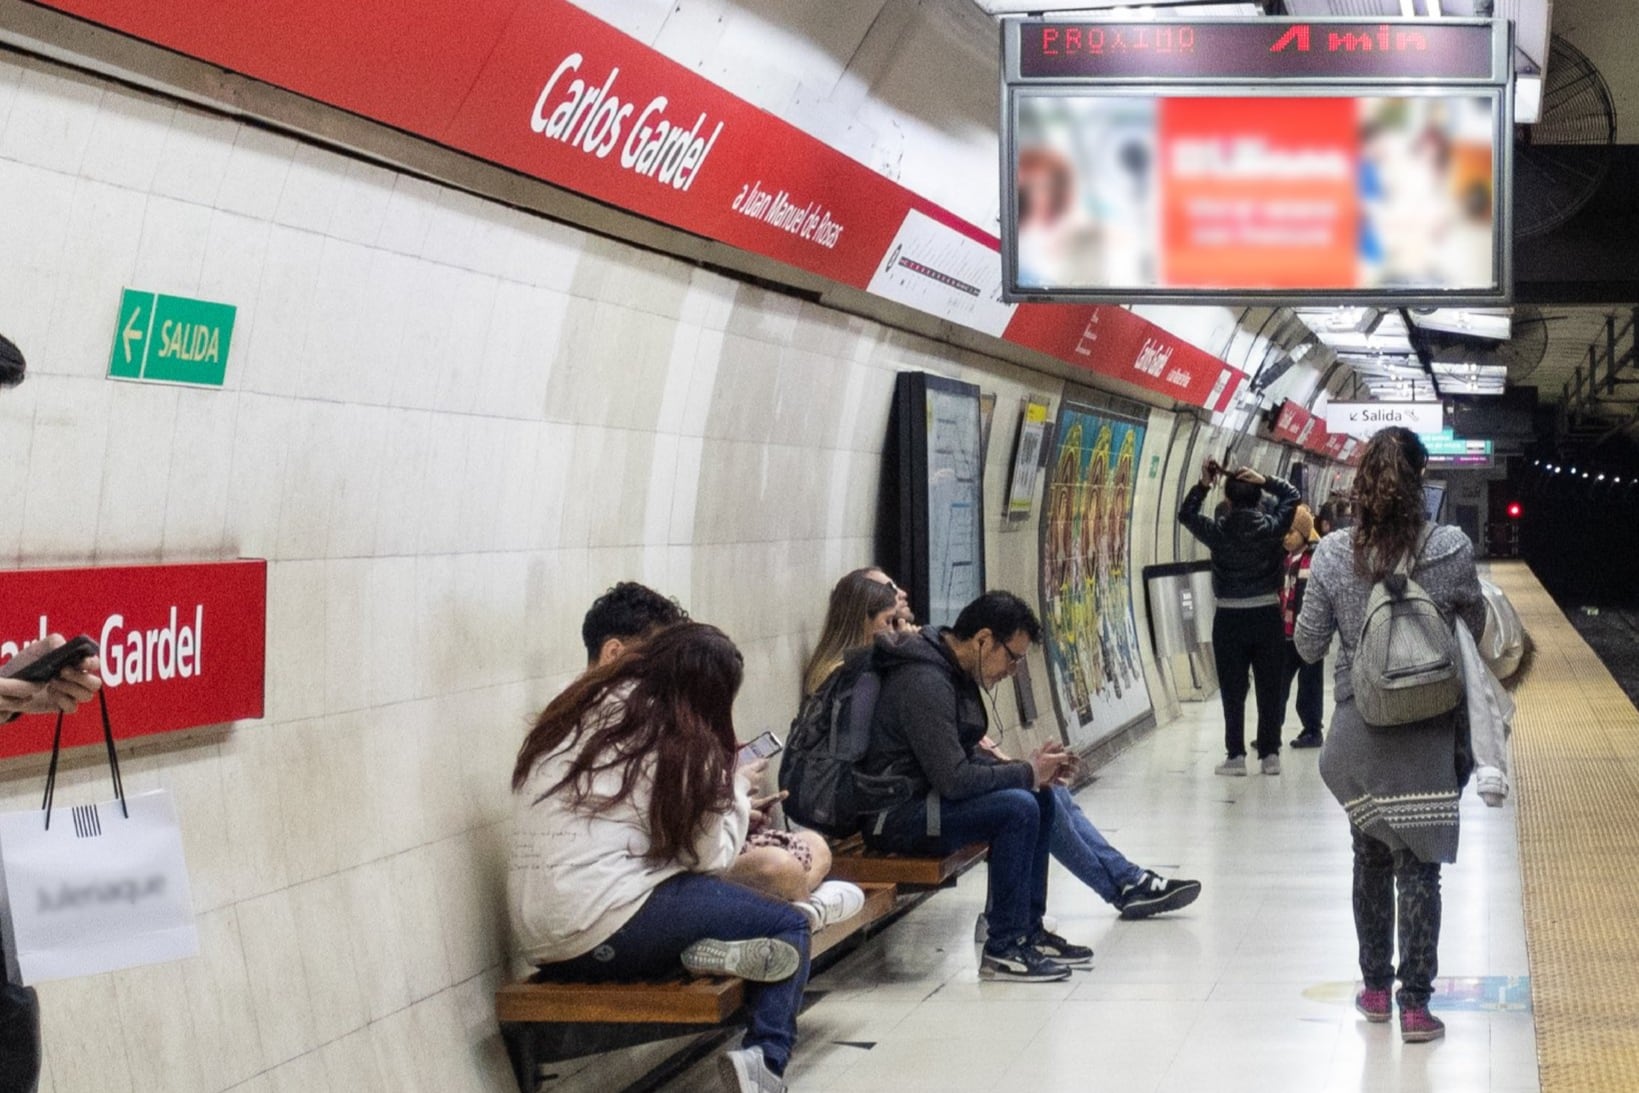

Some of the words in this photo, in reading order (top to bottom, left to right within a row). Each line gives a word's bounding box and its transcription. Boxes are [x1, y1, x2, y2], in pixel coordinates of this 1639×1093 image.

[1328, 24, 1427, 52] min
[530, 52, 635, 159] Carlos
[620, 95, 725, 192] Gardel
[731, 183, 749, 210] a
[738, 180, 772, 220] Juan
[763, 190, 814, 234] Manuel
[799, 204, 822, 240] de
[811, 210, 844, 249] Rosas
[158, 319, 220, 364] SALIDA
[1362, 409, 1402, 422] Salida
[101, 604, 203, 688] Gardel
